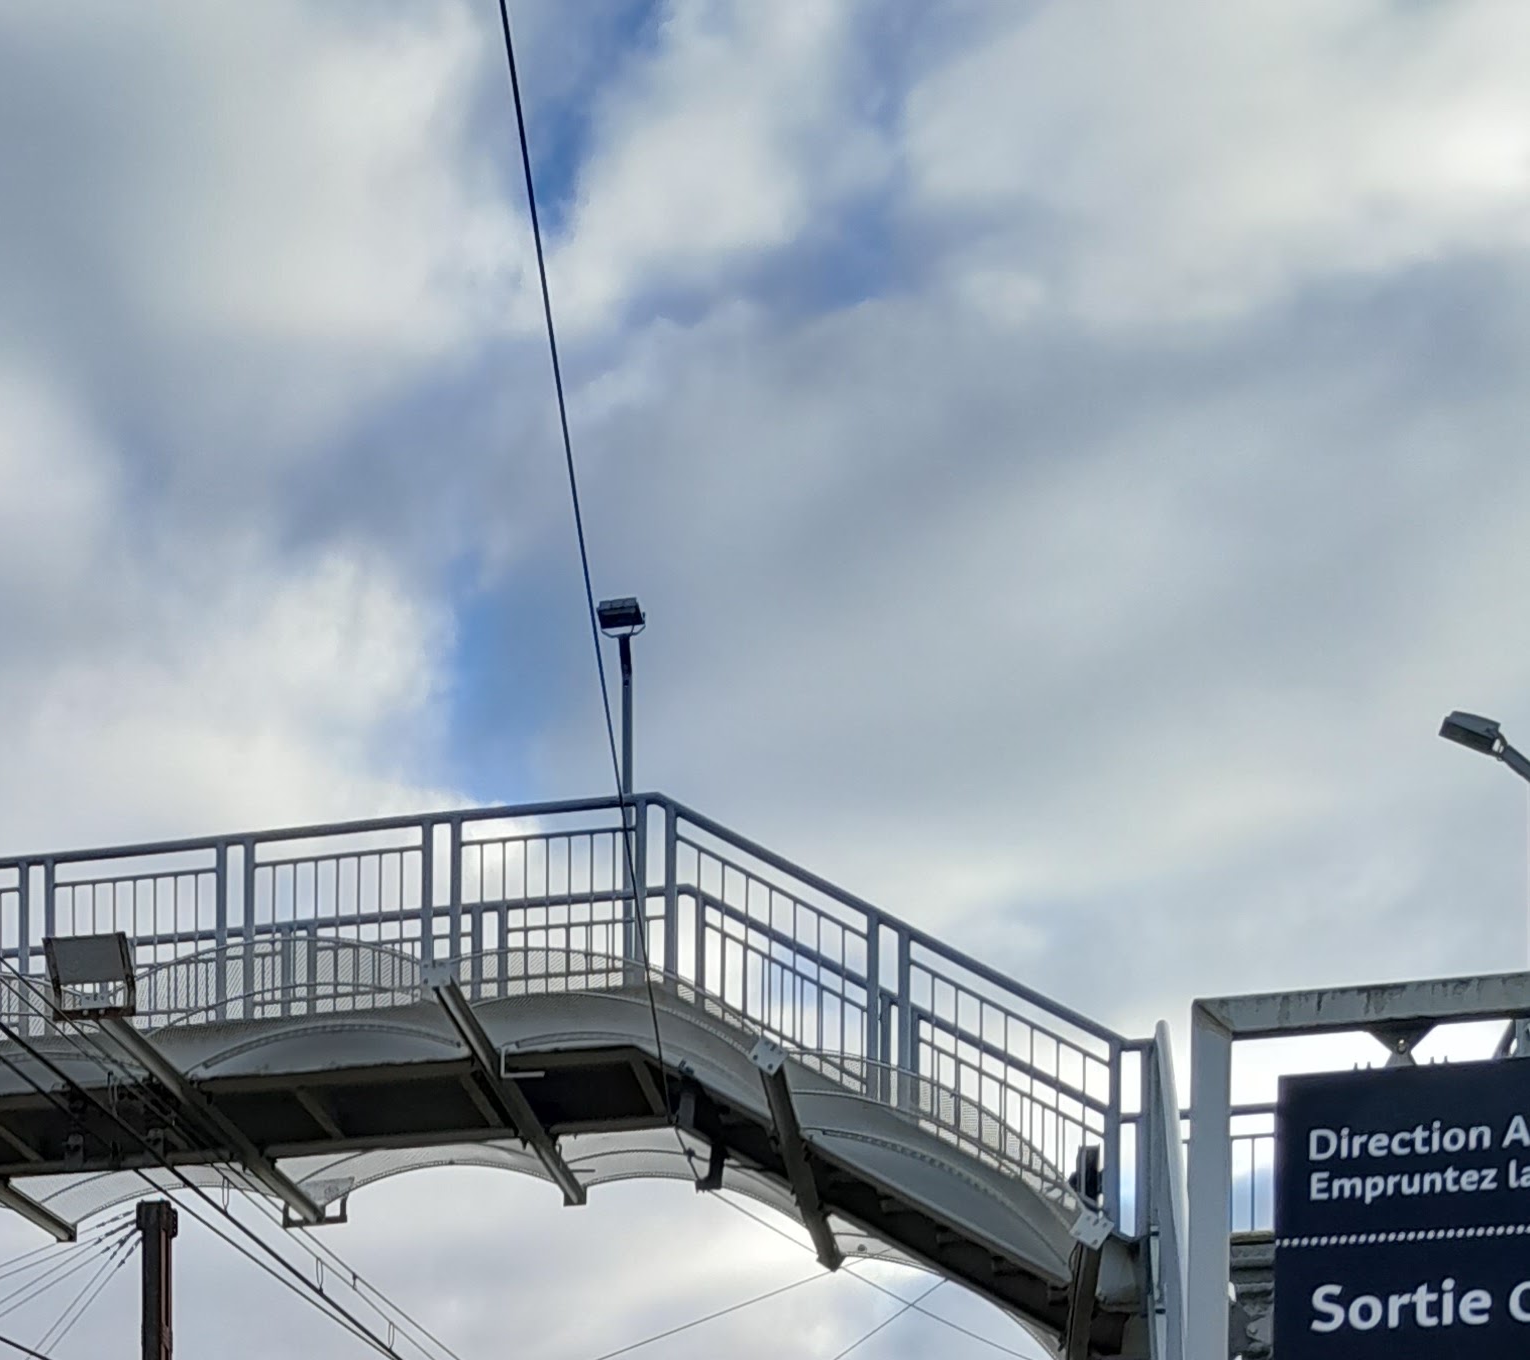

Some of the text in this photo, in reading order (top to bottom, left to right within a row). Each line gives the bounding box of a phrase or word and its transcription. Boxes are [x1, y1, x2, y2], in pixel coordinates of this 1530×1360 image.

[1309, 1120, 1492, 1161] Direction
[1310, 1165, 1498, 1204] Empruntez
[1310, 1277, 1492, 1333] Sortie
